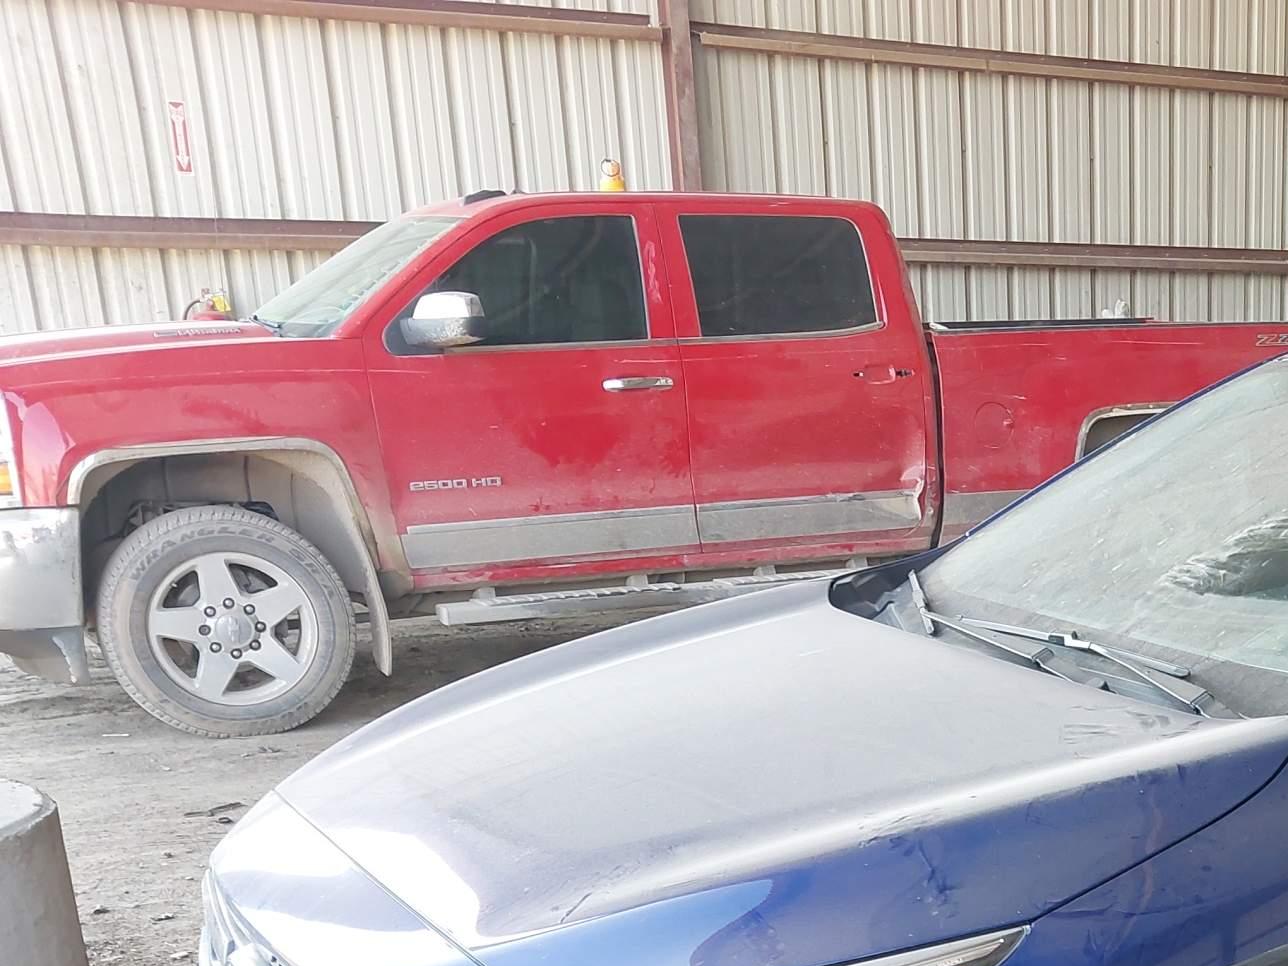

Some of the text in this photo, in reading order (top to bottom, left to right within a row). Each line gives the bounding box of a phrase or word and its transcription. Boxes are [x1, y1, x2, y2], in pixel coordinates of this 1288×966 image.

[409, 476, 502, 492] 2500 HD
[129, 525, 276, 580] WRANGLER
